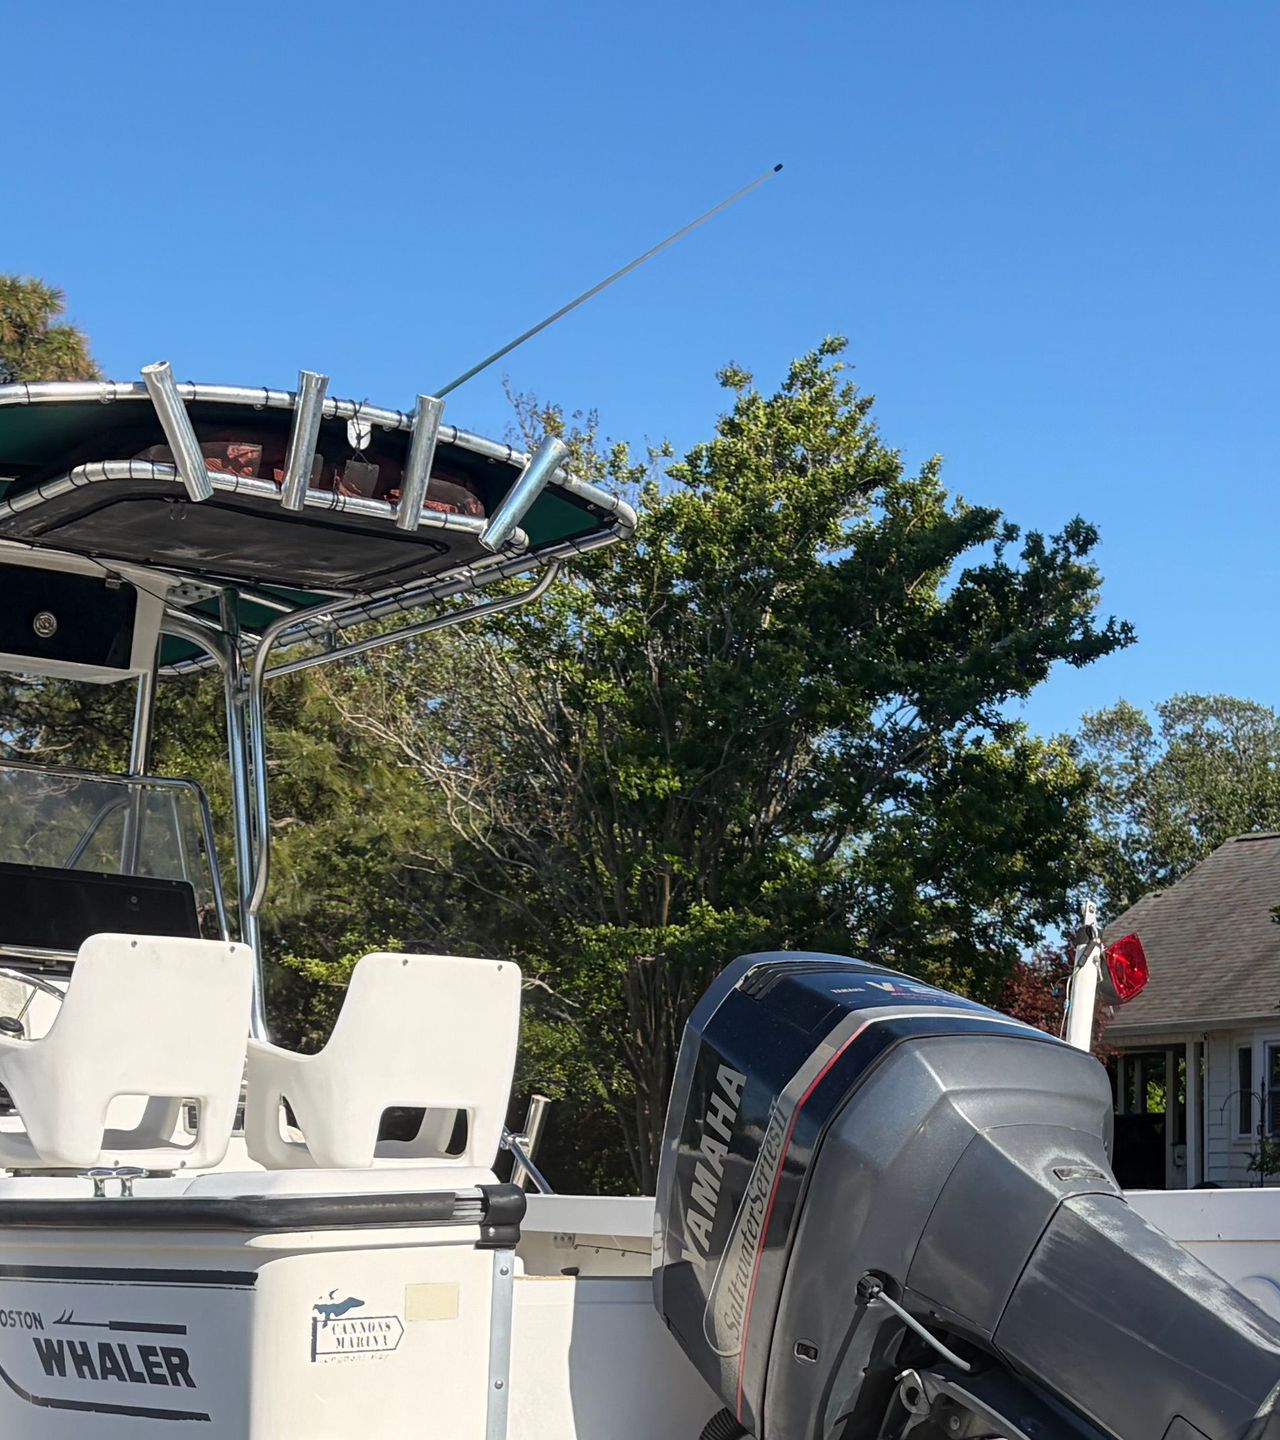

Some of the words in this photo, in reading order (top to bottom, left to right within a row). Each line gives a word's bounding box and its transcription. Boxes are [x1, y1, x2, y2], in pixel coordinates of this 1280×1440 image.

[681, 1063, 748, 1271] YAMAHA
[332, 1321, 392, 1335] CANNONS
[336, 1335, 389, 1349] MARINA
[32, 1337, 197, 1389] WHALER
